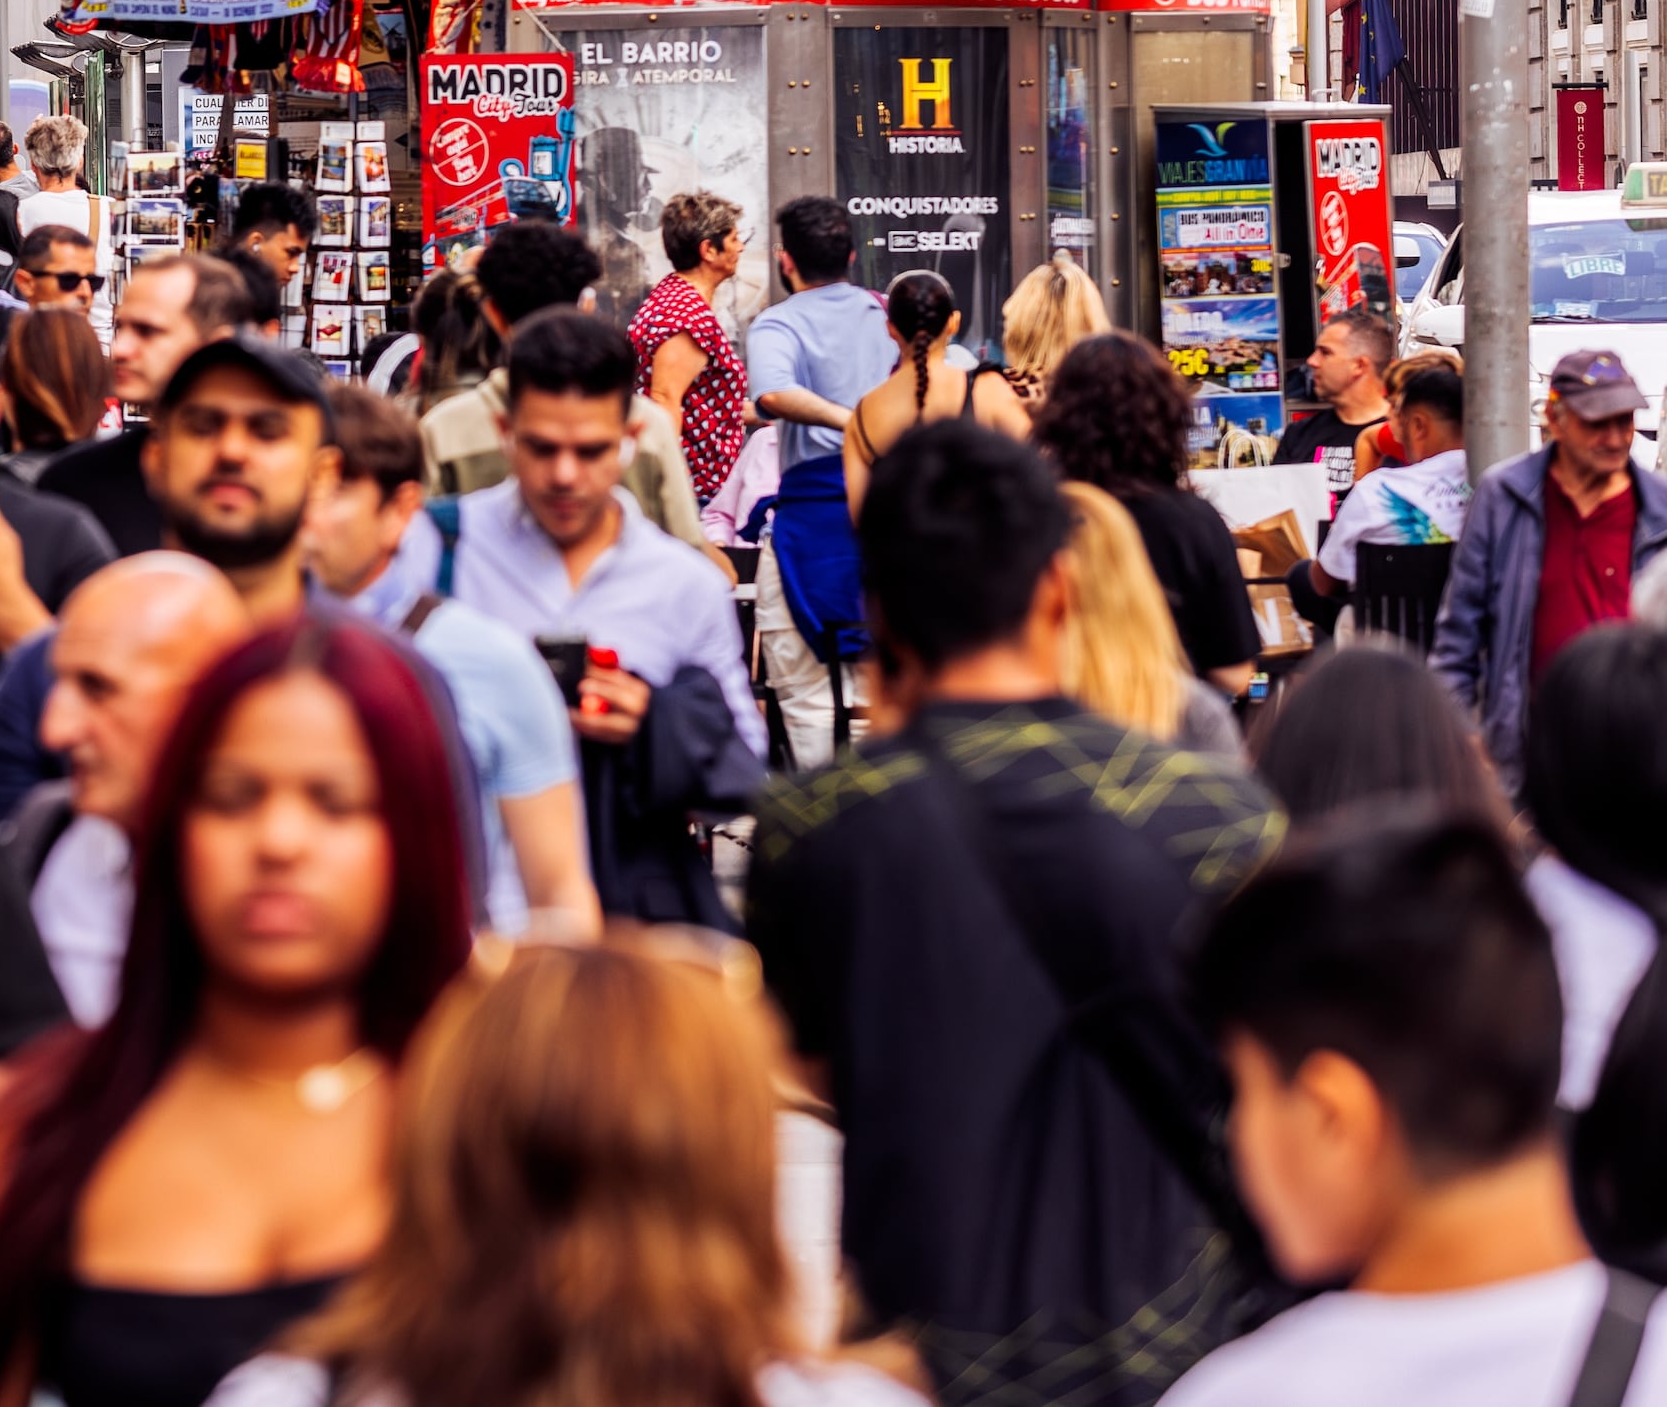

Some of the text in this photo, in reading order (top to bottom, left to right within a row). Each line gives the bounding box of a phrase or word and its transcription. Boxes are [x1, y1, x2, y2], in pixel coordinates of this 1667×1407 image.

[581, 41, 722, 65] EL BARRIO
[429, 65, 565, 103] MADRID
[632, 68, 737, 84] ATEMPORAL
[898, 58, 954, 128] H
[889, 136, 964, 154] HISTORIA
[847, 196, 999, 219] CONQUISTADORES
[1569, 258, 1624, 278] LIBRE
